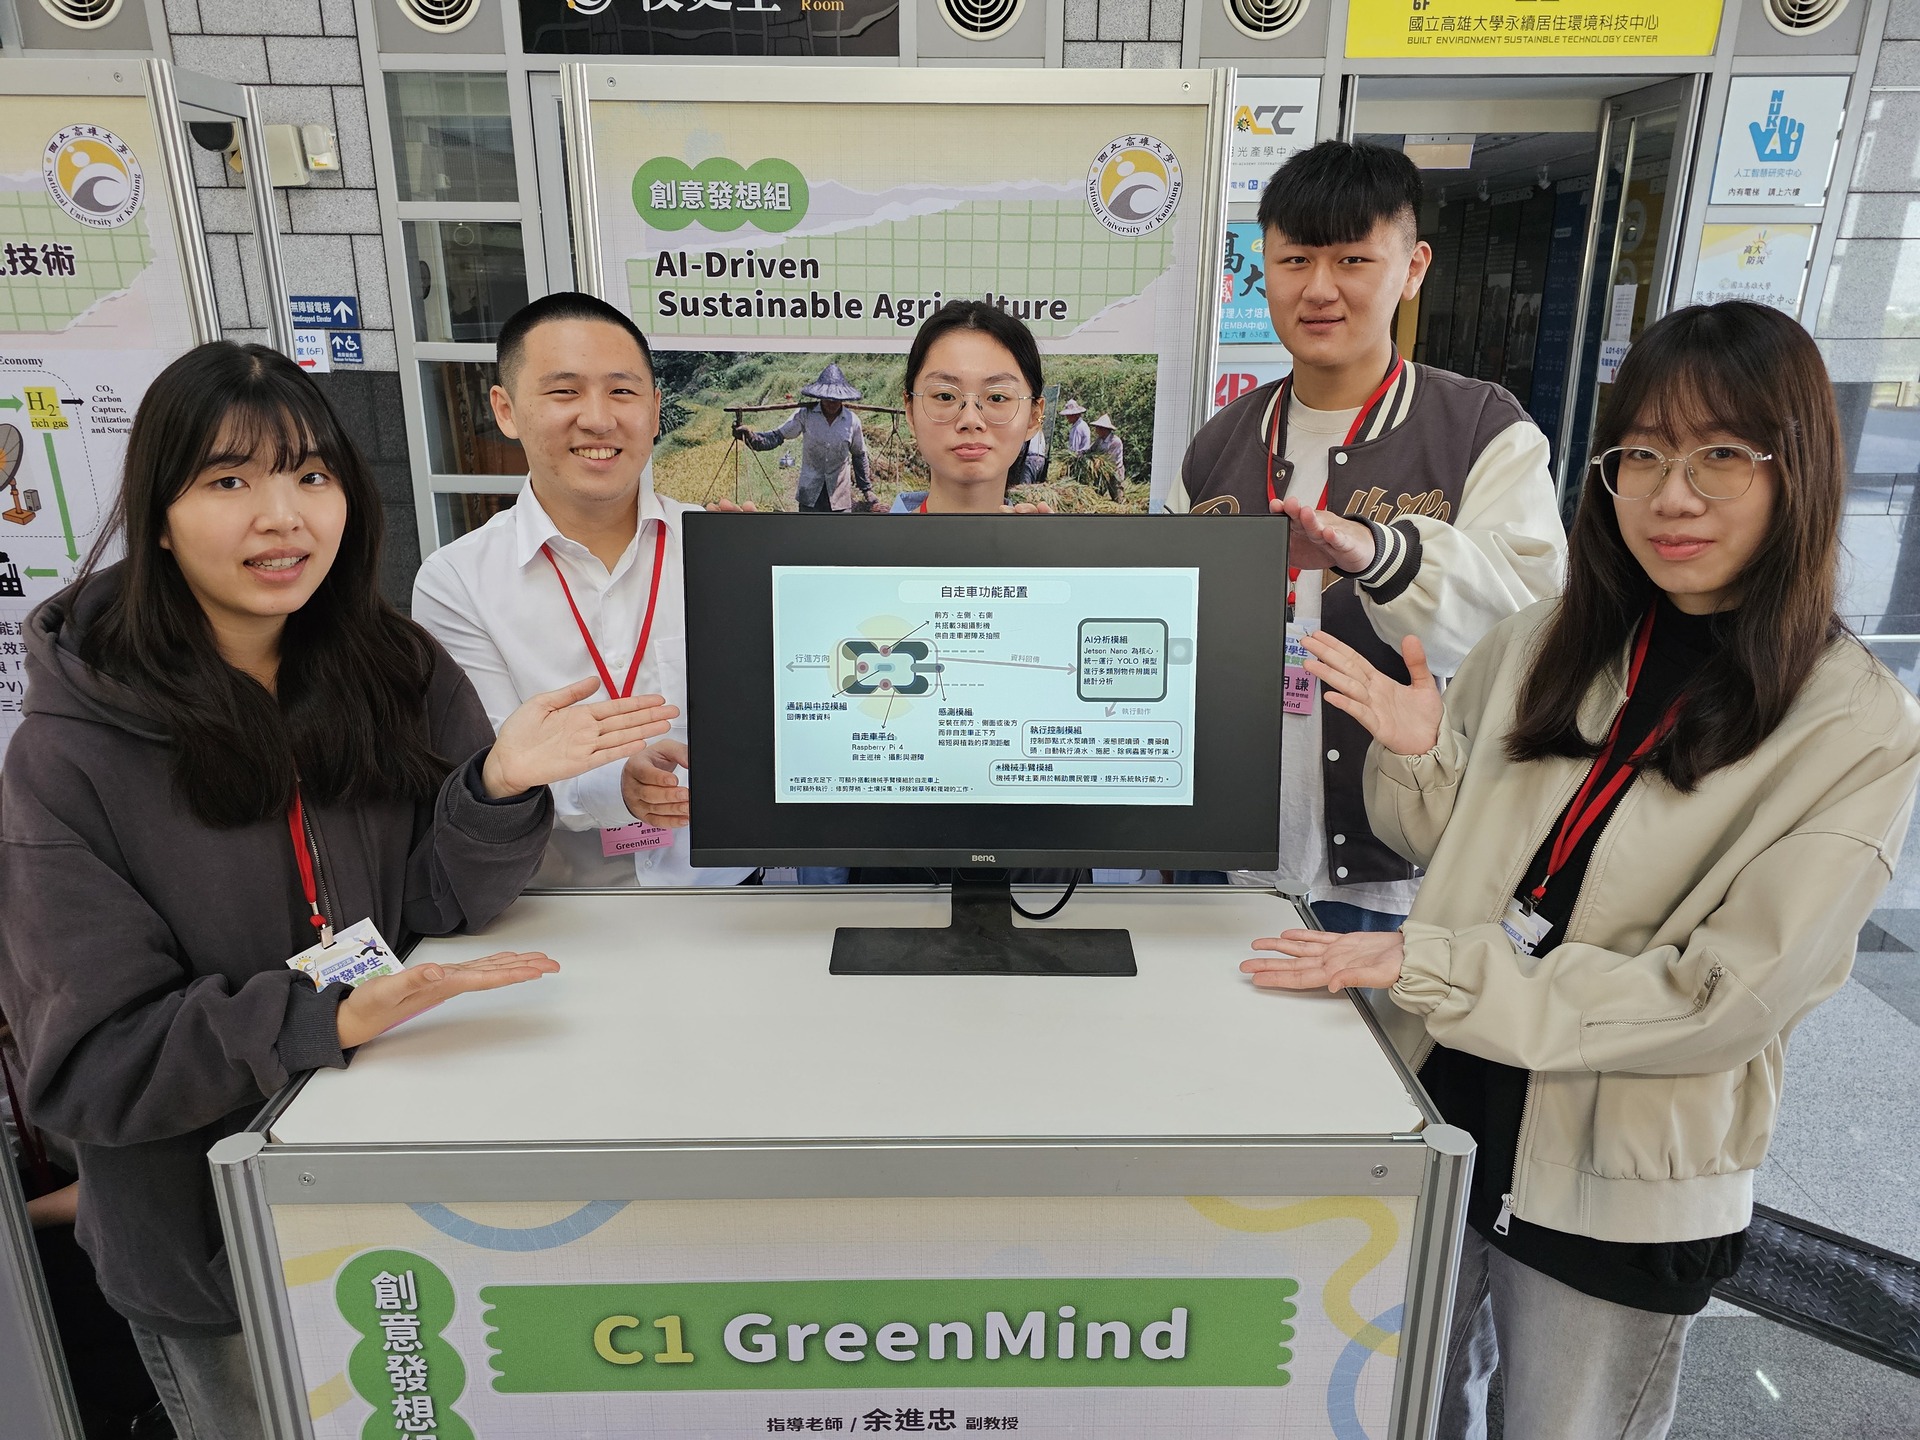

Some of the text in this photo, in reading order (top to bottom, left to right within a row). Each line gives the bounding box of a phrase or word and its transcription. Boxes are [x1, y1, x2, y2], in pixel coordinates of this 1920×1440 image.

[801, 0, 845, 11] Room
[1408, 14, 1660, 32] 國立高雄大學永續居住環境科技中心
[1407, 36, 1433, 45] BUILT
[1436, 35, 1503, 44] ENVIRONMENT
[1562, 35, 1621, 44] TECHNOLOGY
[1623, 35, 1658, 43] CENTER
[1234, 105, 1304, 135] ACC
[48, 125, 129, 155] 國立高雄大學
[1097, 136, 1176, 164] 國立高雄大學
[45, 169, 142, 228] National University of Kaohsiung
[649, 180, 791, 212] 創意發想組
[1088, 178, 1182, 235] National University of Kaohsiung
[0, 243, 76, 276] 技術
[654, 250, 820, 279] AI-Driven
[658, 289, 1067, 327] Sustainable Agrilture
[92, 395, 122, 403] Carbon
[91, 406, 127, 414] Capture,
[31, 418, 69, 430] rich gas
[91, 416, 132, 424] Utilization
[108, 426, 132, 435] Storag
[941, 586, 1028, 599] 自走車功能配置
[1084, 635, 1129, 644] AI分析模組
[1083, 647, 1107, 655] Jetson
[1110, 647, 1128, 655] Nano
[795, 654, 830, 663] 行進方向
[786, 701, 848, 711] 通訊與中控模組
[938, 707, 974, 717] 感測模組
[1030, 725, 1083, 735] 執行控制模組
[852, 732, 896, 741] 自走車平台
[852, 743, 886, 752] Raspberry
[889, 743, 896, 751] Pi
[616, 837, 661, 851] GreenMind
[594, 1305, 1188, 1365] C1 GreenMind
[767, 1417, 844, 1433] 指導老師
[863, 1408, 957, 1433] 余進忠
[966, 1416, 1019, 1431] 副教授
